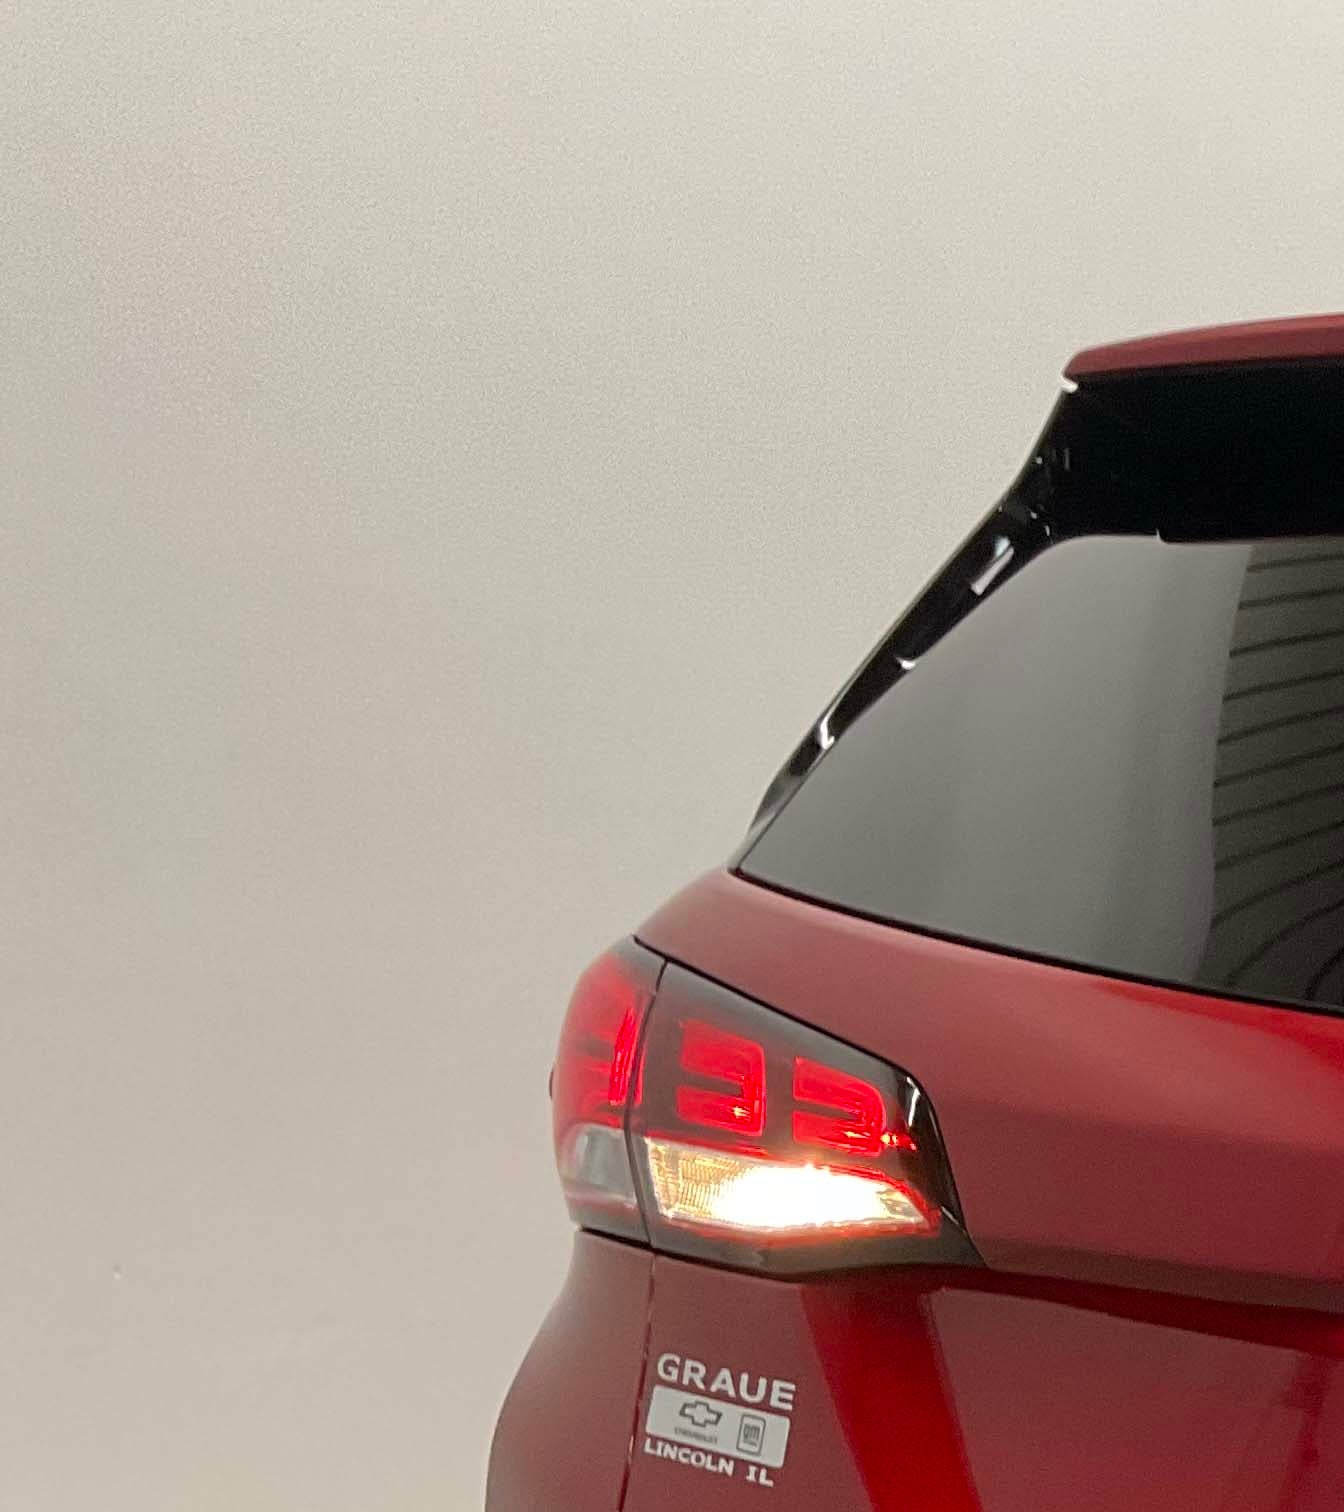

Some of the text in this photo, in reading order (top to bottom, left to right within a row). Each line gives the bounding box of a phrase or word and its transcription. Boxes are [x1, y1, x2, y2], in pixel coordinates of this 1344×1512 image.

[657, 1353, 796, 1411] GRAUE
[644, 1438, 774, 1487] LINCOLN IL
